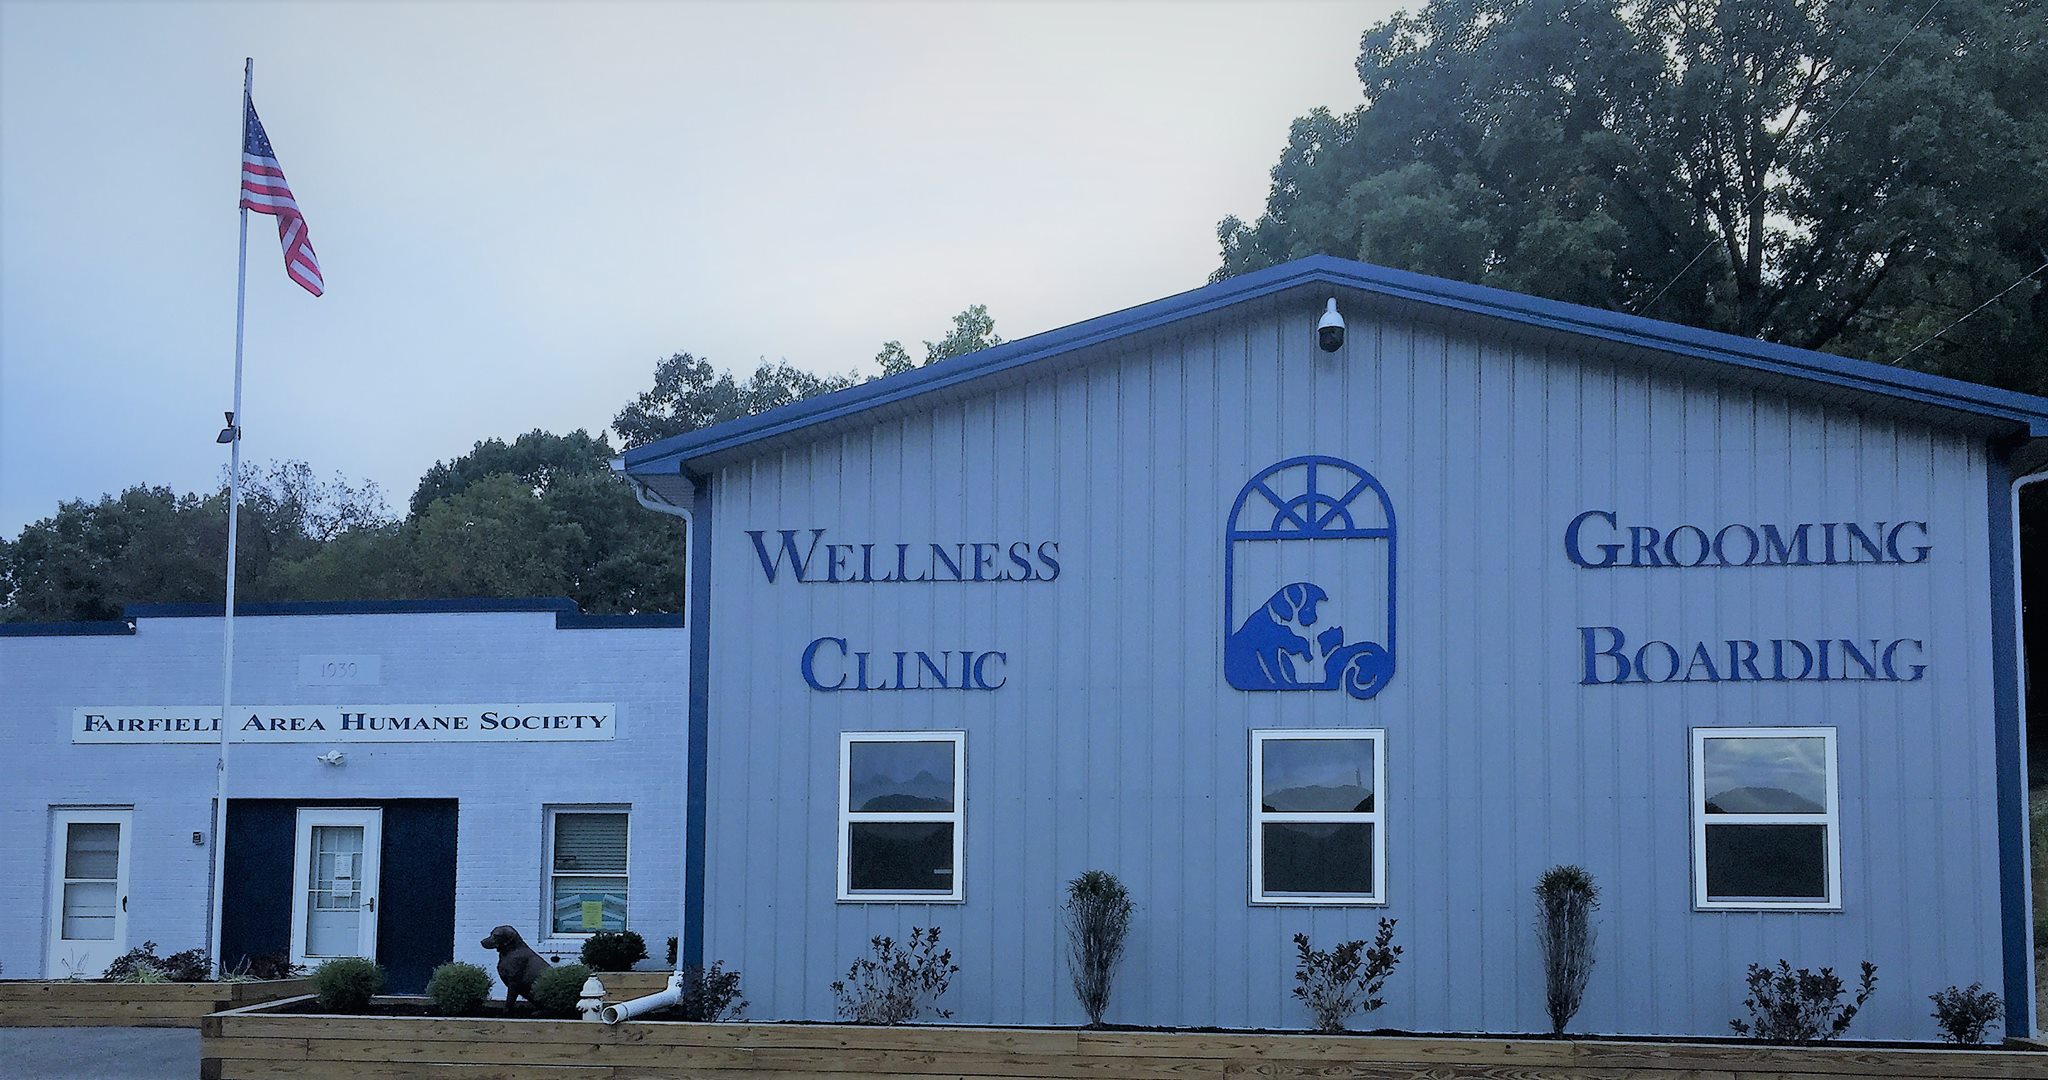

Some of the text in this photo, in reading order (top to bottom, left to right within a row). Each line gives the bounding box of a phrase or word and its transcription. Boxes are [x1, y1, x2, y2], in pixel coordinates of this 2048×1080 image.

[744, 528, 1061, 583] WELLNESS
[1565, 510, 1933, 569] GROOMING
[321, 662, 358, 679] 1939
[801, 636, 1007, 692] CLINIC
[1577, 626, 1928, 685] BOARDING
[240, 713, 326, 731] AREA
[340, 713, 469, 731] HUMANE
[480, 711, 608, 730] SOCIETY
